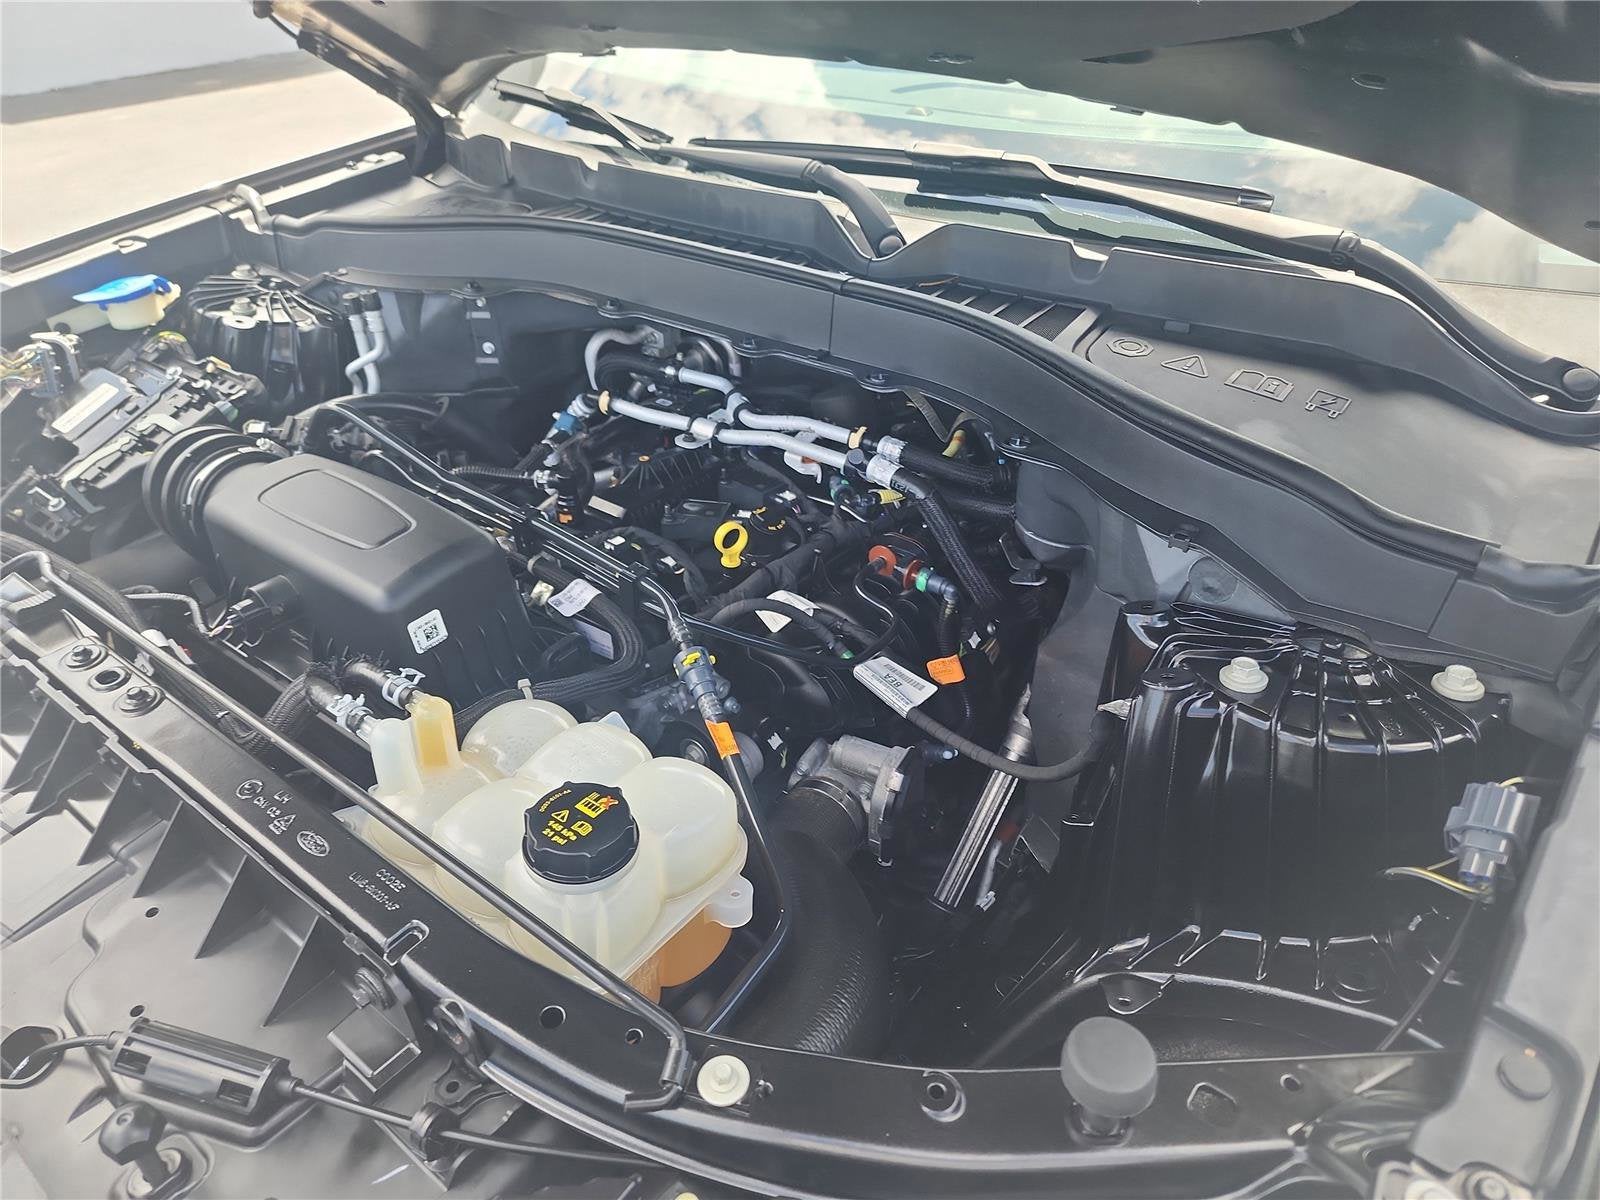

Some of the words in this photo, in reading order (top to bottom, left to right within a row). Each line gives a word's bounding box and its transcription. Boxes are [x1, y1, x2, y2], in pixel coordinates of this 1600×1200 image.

[273, 790, 293, 803] LH
[542, 828, 553, 838] 21
[551, 835, 568, 846] psi
[547, 820, 564, 832] 145
[561, 828, 578, 842] kPa
